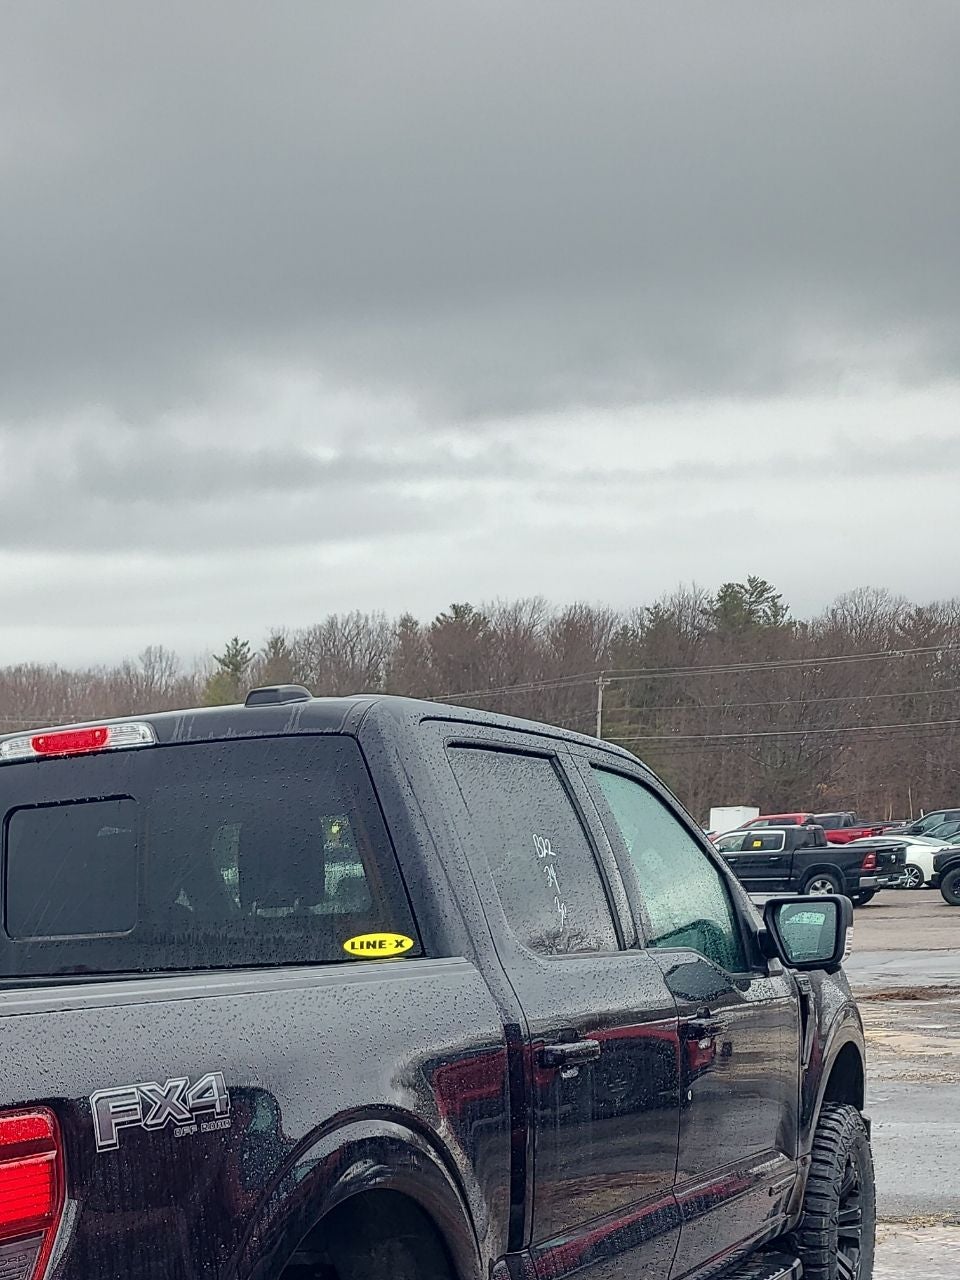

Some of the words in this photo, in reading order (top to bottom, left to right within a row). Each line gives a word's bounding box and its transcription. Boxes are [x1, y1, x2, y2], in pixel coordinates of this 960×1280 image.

[89, 1071, 231, 1154] FX4
[173, 1124, 198, 1138] OFF
[200, 1118, 231, 1133] ROAD
